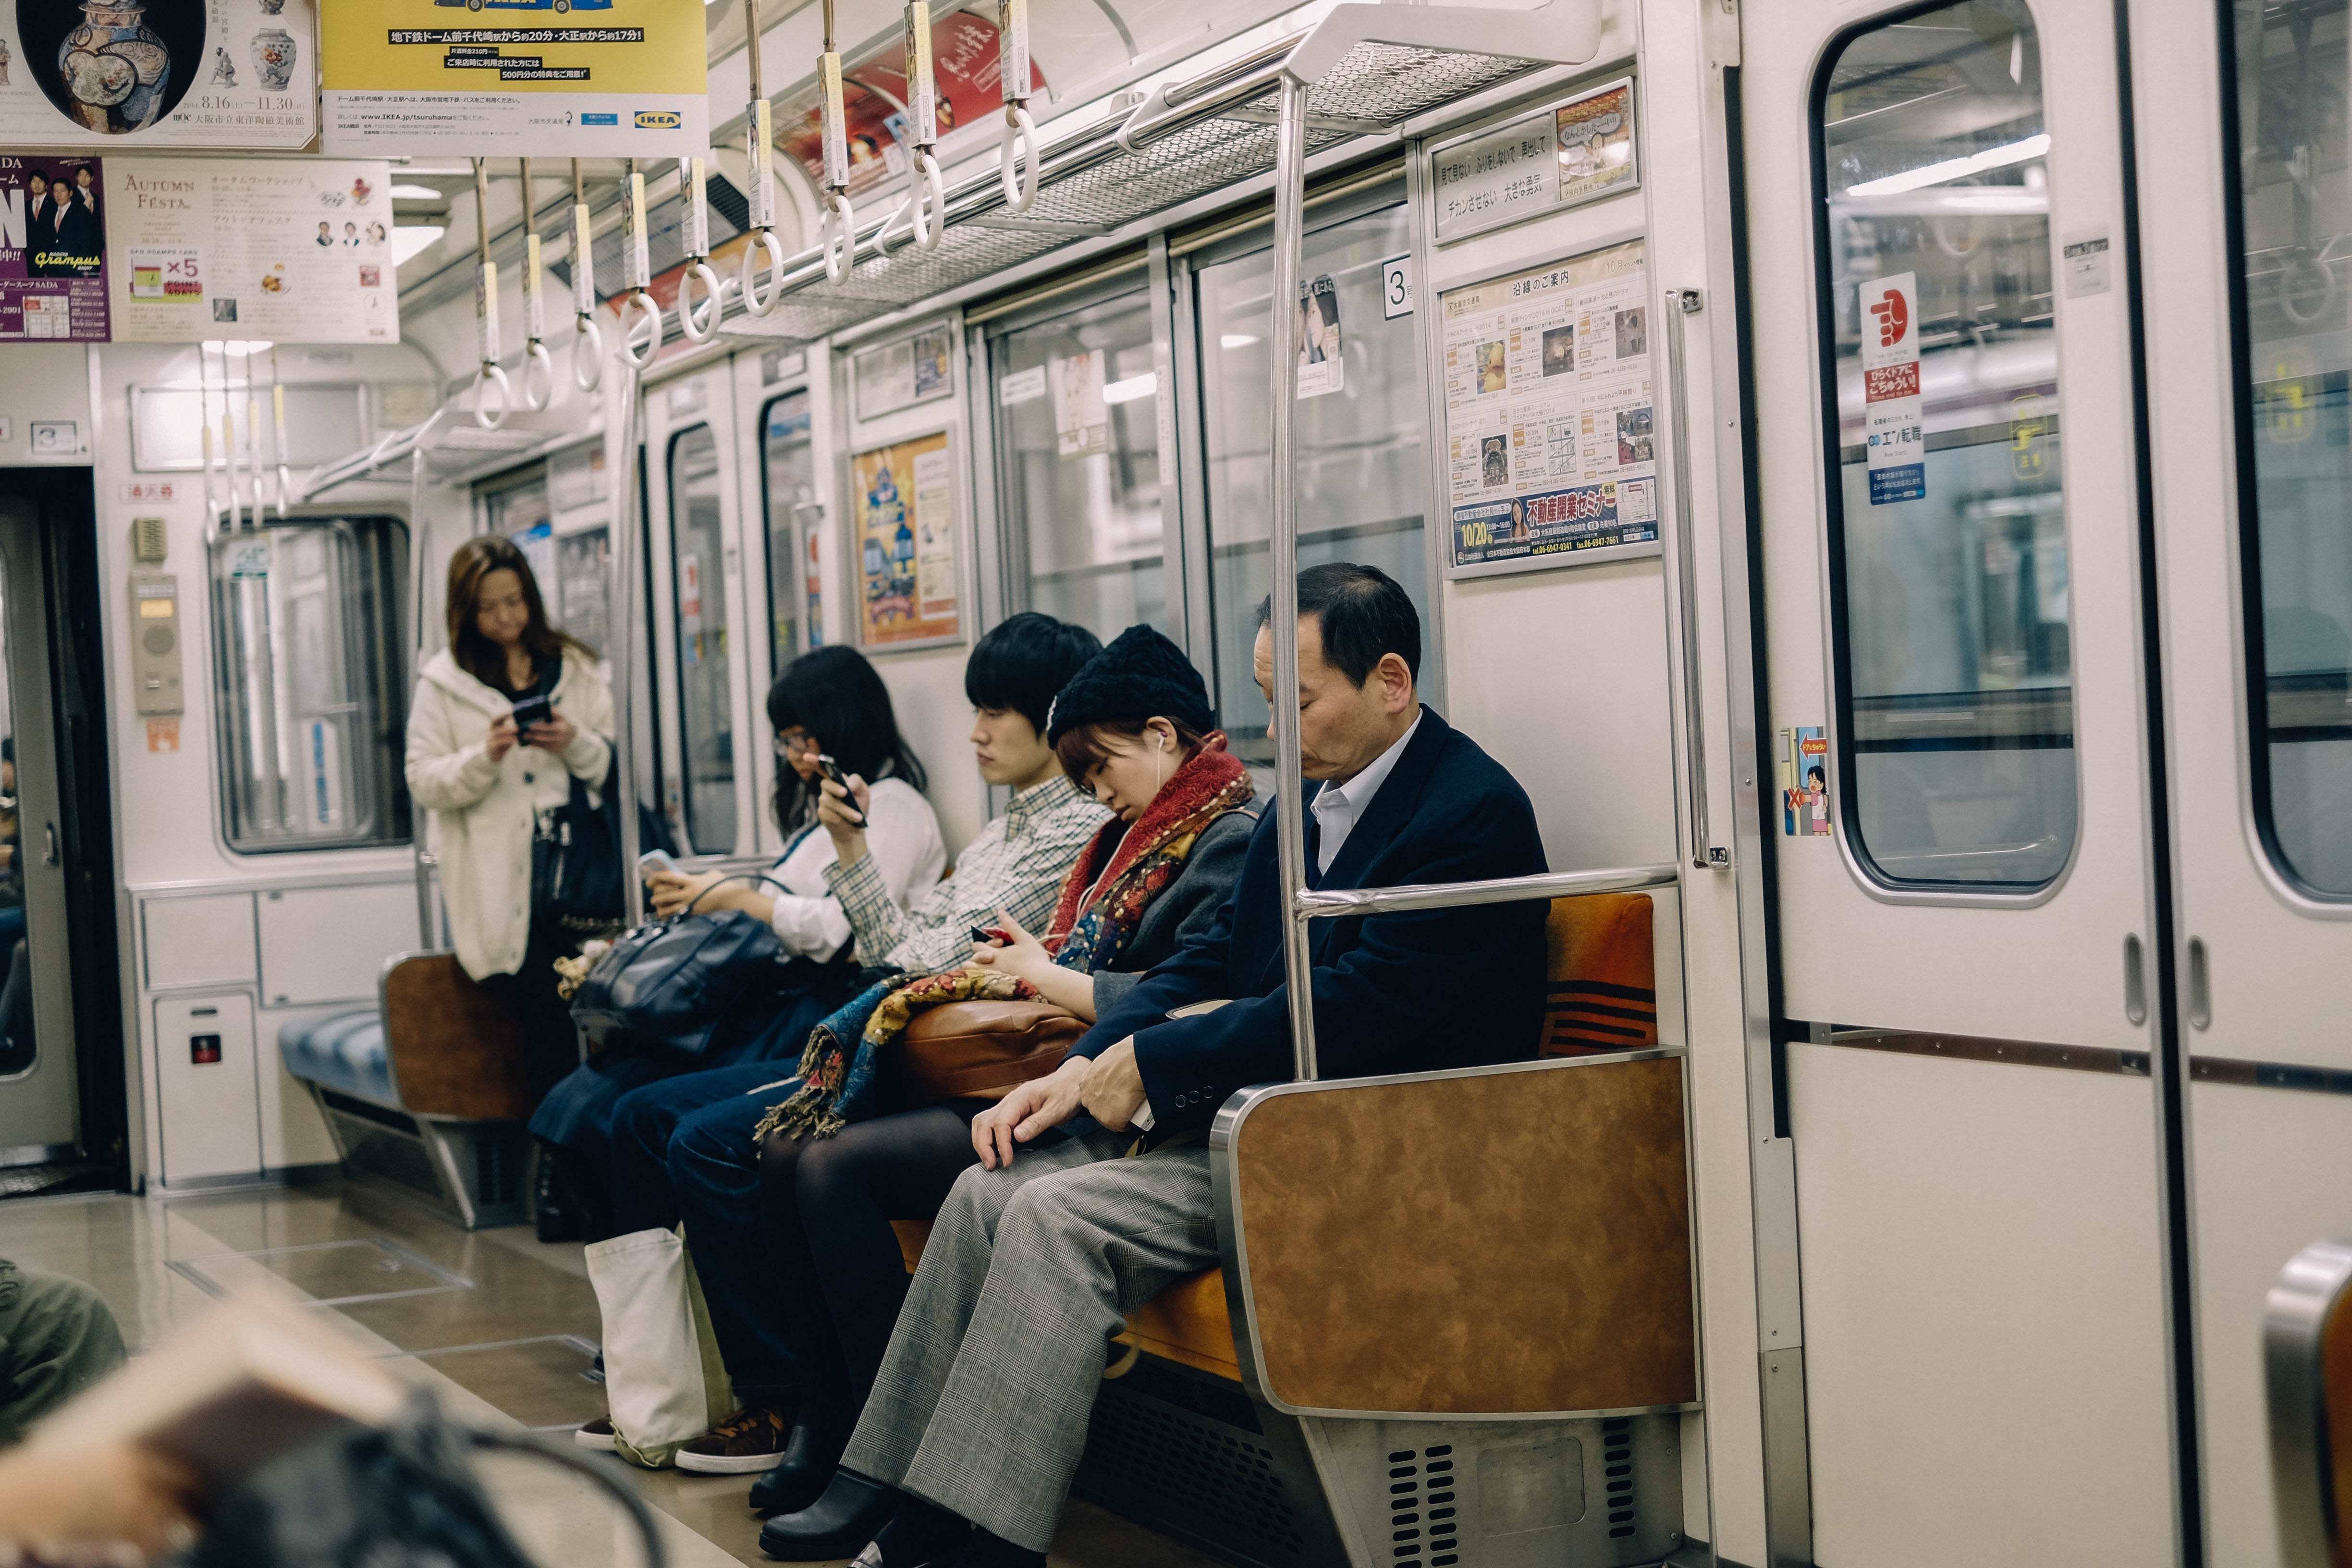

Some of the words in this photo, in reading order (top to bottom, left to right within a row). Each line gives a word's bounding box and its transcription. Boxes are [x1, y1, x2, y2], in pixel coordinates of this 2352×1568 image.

[196, 115, 304, 125] 大阪市立東洋陶磁美術館
[1442, 161, 1470, 186] 見て見ない
[1477, 146, 1515, 173] ふりをしないで
[1521, 136, 1546, 160] 声出して
[138, 193, 191, 208] FESTA
[1448, 189, 1497, 219] チカンさせない
[1505, 174, 1542, 203] 大きな勇気
[35, 252, 100, 268] Grampus
[1513, 270, 1569, 297] 沿線のご案内
[1871, 364, 1913, 381] ひらくドアに
[1869, 375, 1917, 394] ごちゅうい!
[1882, 425, 1922, 446] エン転職
[1527, 489, 1616, 527] 不動産開業セミナー
[1461, 522, 1487, 547] 10/20
